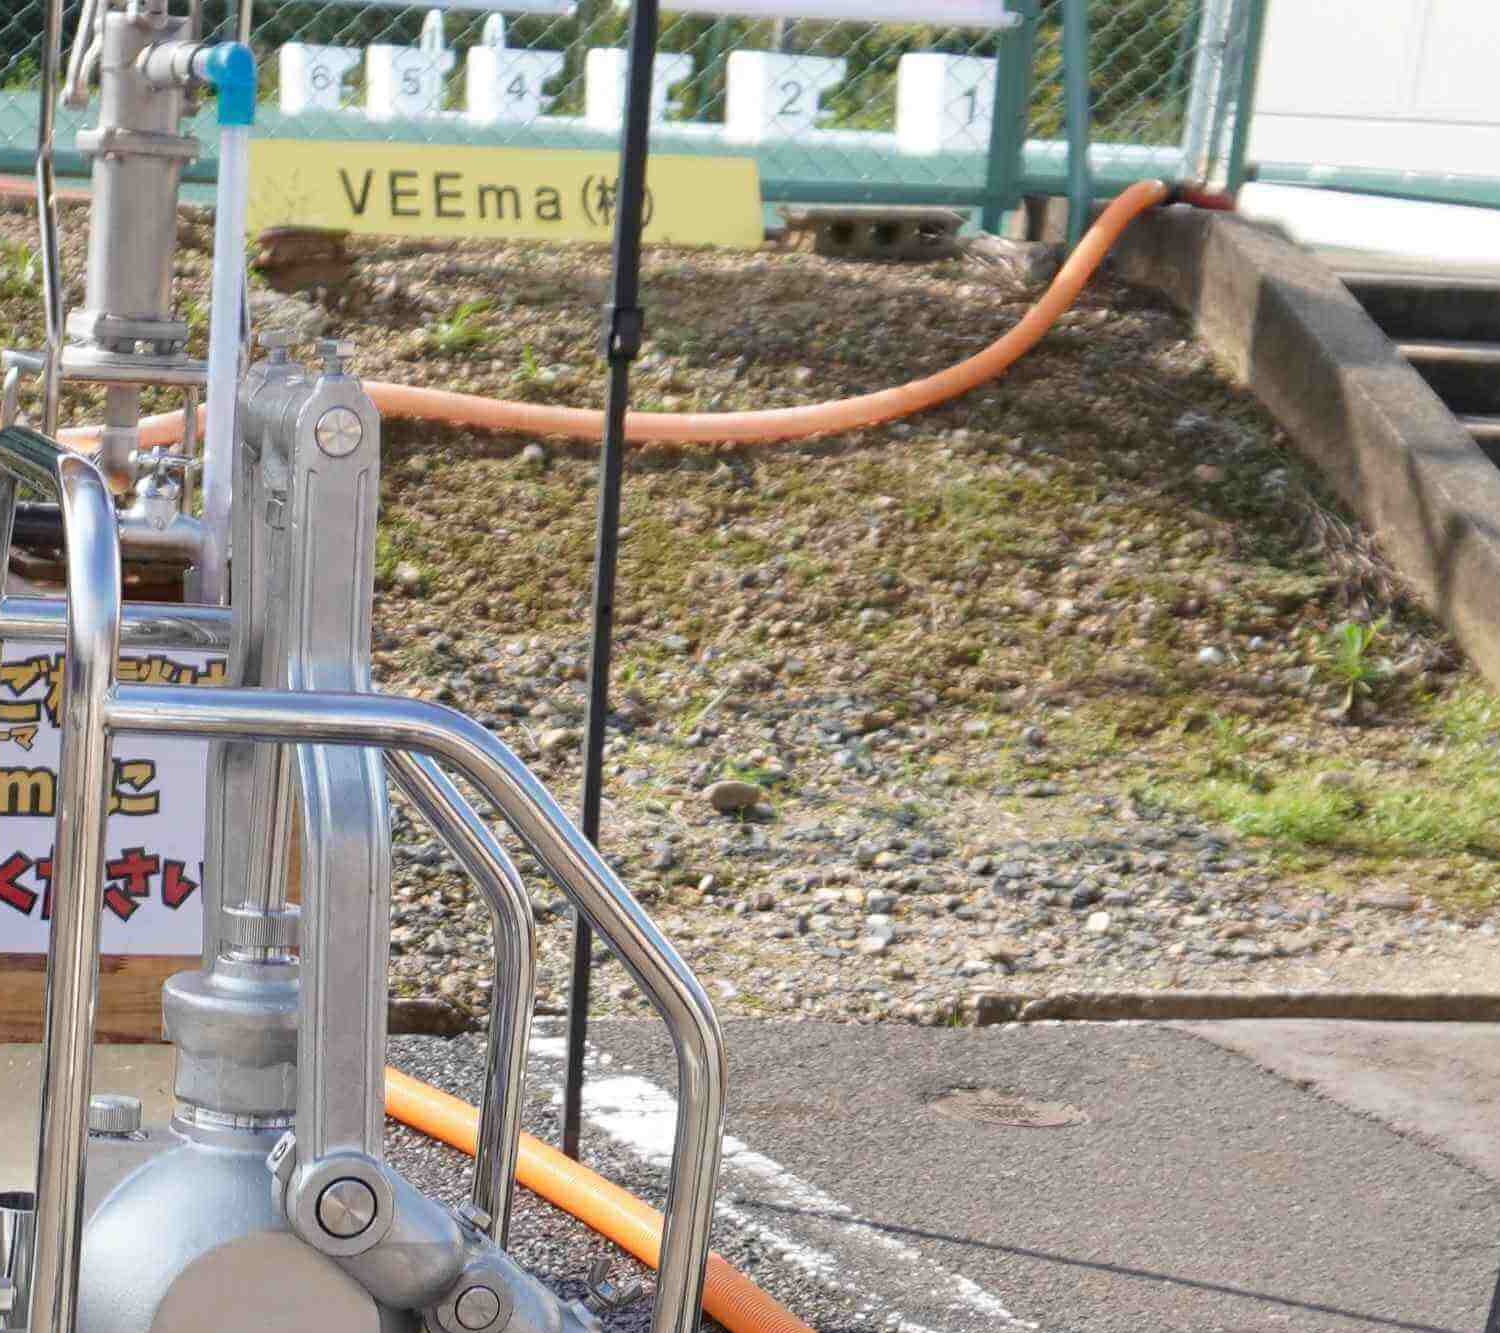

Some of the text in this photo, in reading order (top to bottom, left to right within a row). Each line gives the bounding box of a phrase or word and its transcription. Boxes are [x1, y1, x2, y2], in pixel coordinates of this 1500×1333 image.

[311, 64, 331, 90] 6
[402, 67, 420, 95] 5
[506, 74, 527, 97] 4
[777, 80, 801, 116] 2
